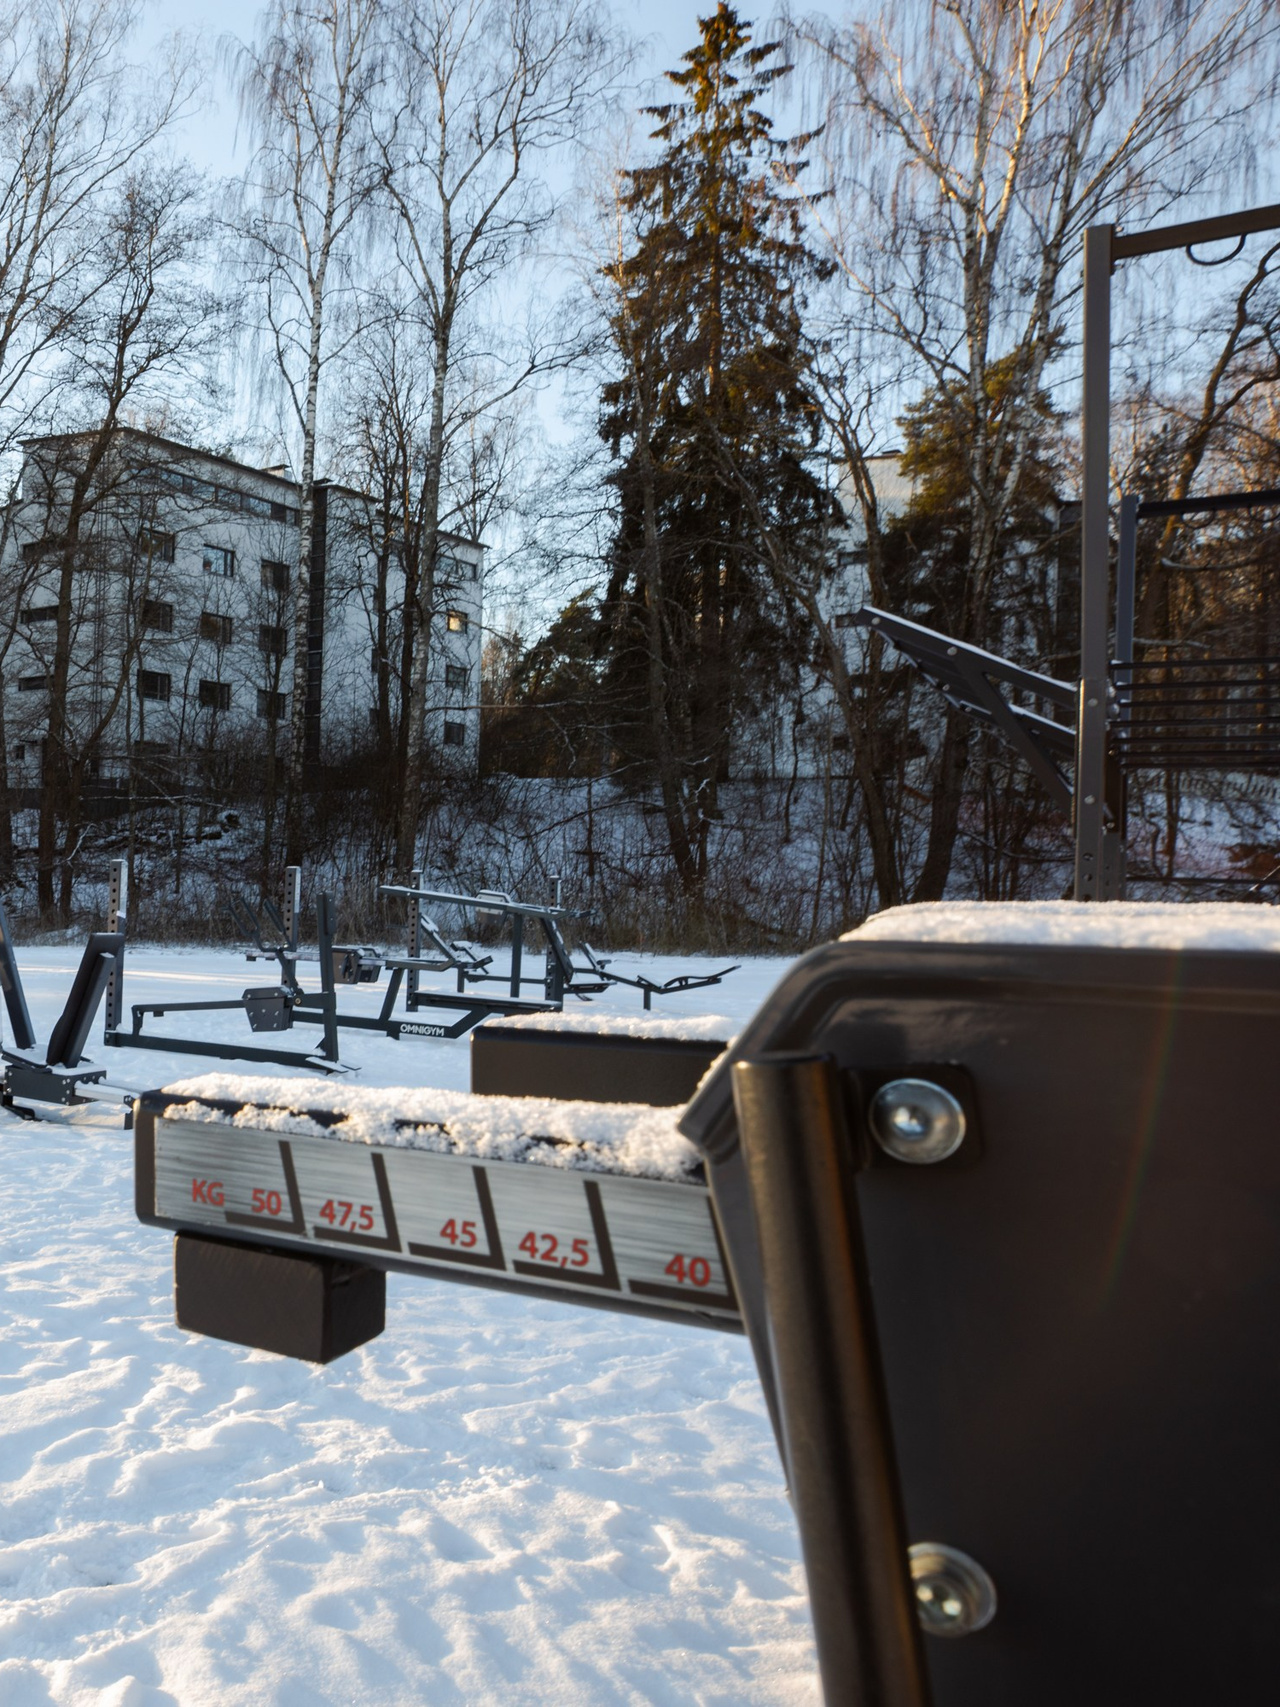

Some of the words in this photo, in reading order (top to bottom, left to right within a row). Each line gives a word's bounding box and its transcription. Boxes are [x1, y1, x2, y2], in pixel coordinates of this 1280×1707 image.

[400, 1023, 445, 1037] OMNIGYM
[191, 1178, 225, 1207] KG
[251, 1188, 282, 1216] 50
[319, 1199, 375, 1232] 47,5
[440, 1218, 477, 1248] 45
[518, 1230, 589, 1268] 42,5
[665, 1254, 711, 1287] 40
